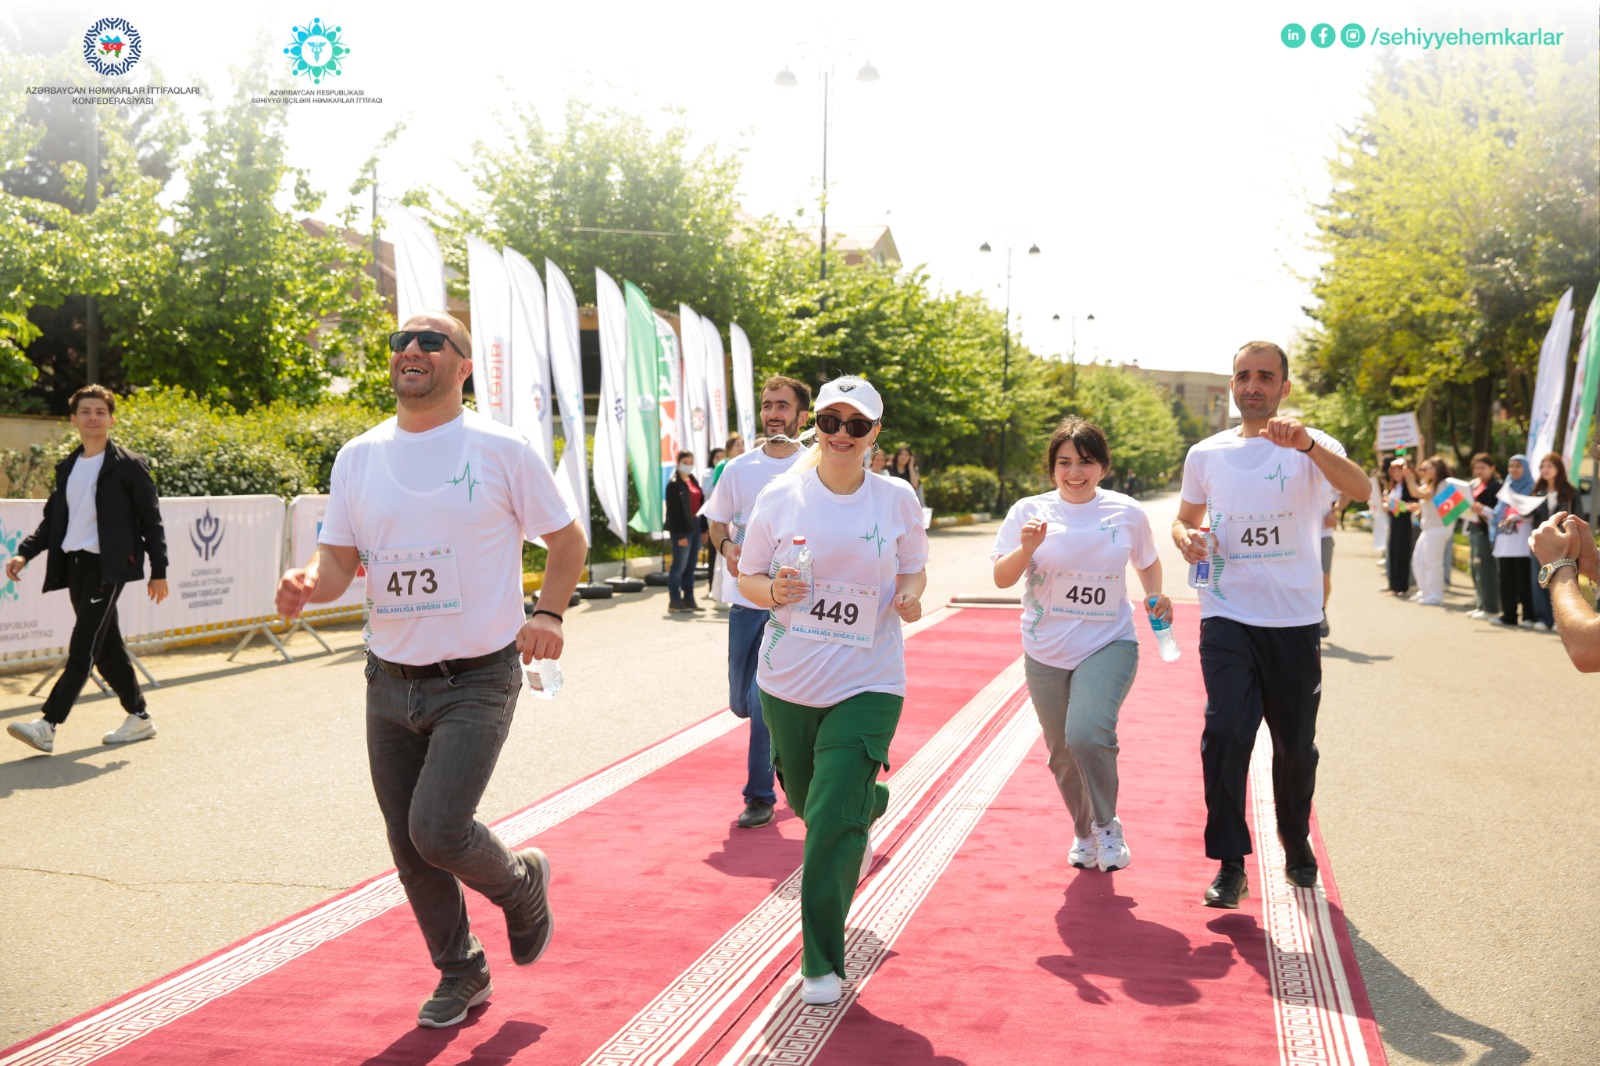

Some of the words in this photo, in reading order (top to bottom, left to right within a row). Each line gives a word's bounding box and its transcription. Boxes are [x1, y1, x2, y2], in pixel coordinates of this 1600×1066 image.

[1240, 525, 1280, 547] 451
[386, 568, 439, 597] 473
[1065, 585, 1106, 606] 450
[376, 605, 415, 614] SAĞLAMLIĞA
[416, 602, 441, 611] DOĞRU
[810, 598, 859, 626] 449
[791, 626, 831, 637] SAĞLAMLIĞA
